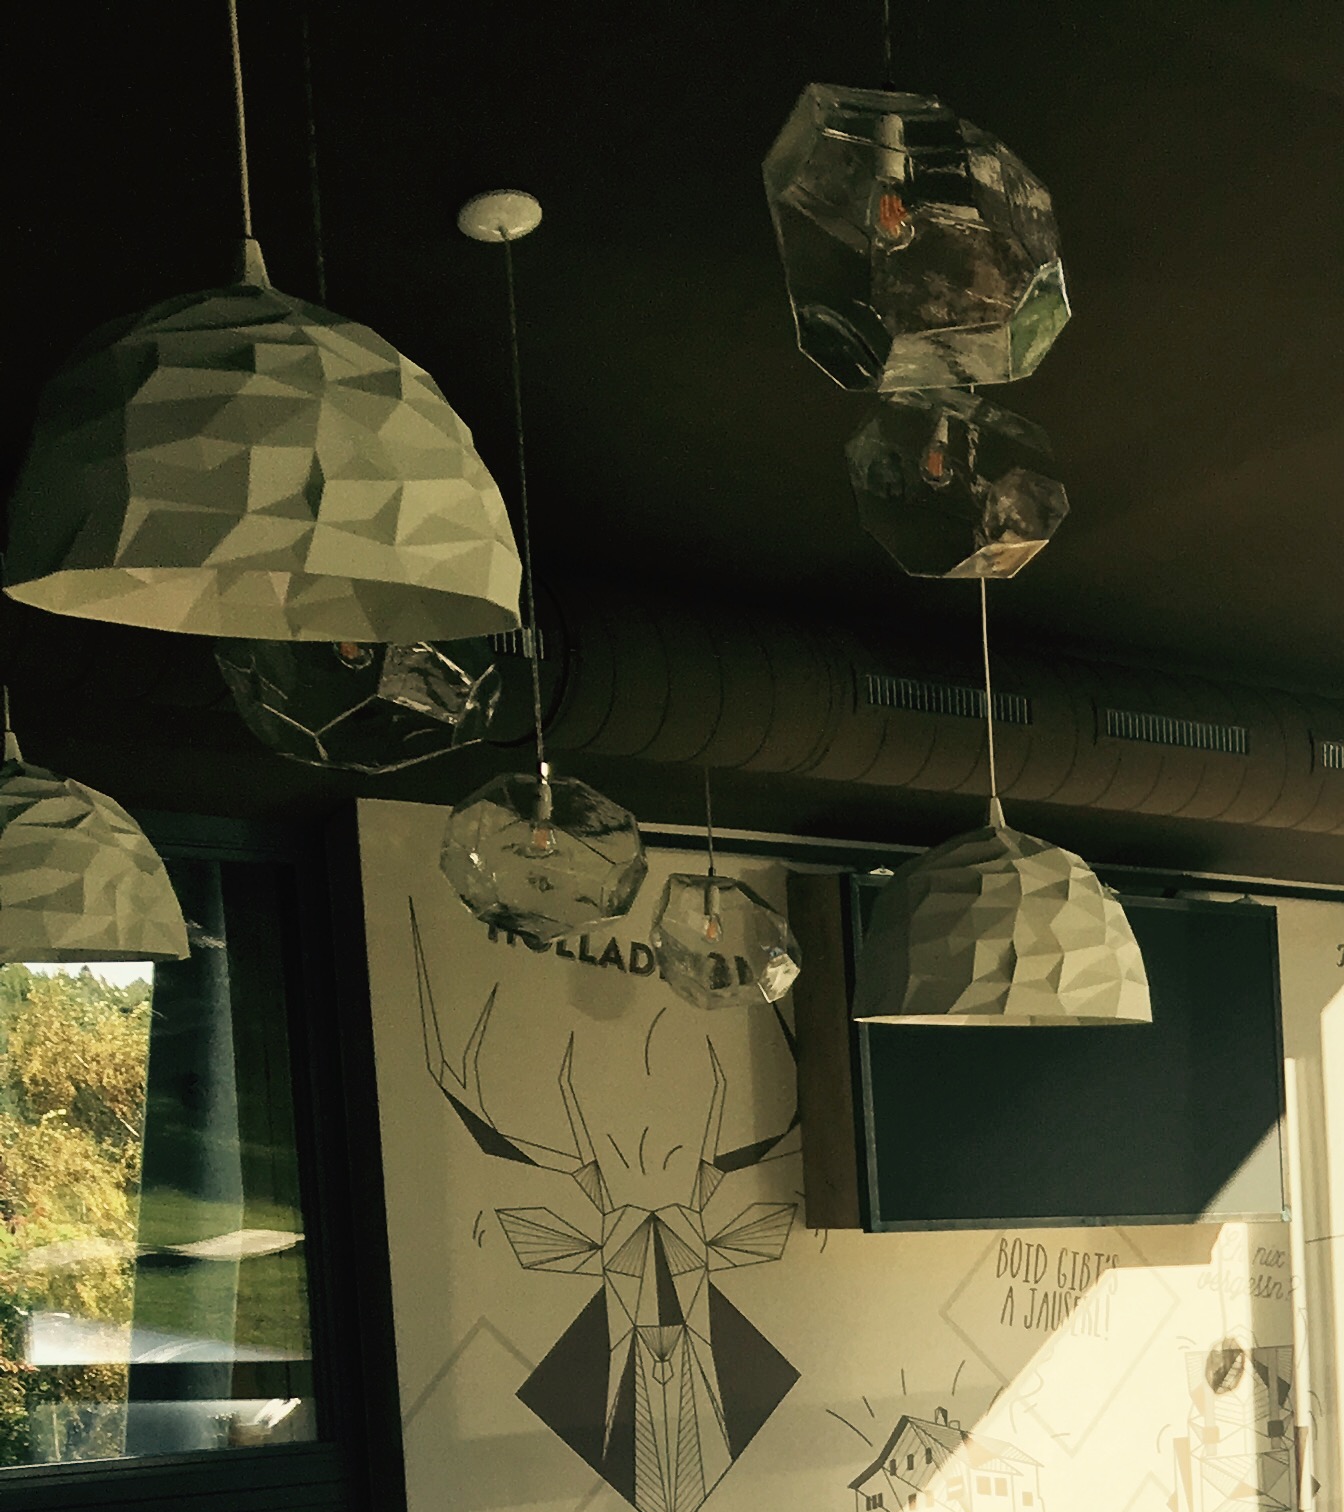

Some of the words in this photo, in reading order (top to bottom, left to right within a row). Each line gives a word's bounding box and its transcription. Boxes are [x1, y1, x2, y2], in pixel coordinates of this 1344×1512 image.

[996, 1237, 1049, 1285] BOID
[1057, 1246, 1121, 1296] GIBT'S
[1252, 1246, 1287, 1269] nix
[1000, 1285, 1015, 1327] A
